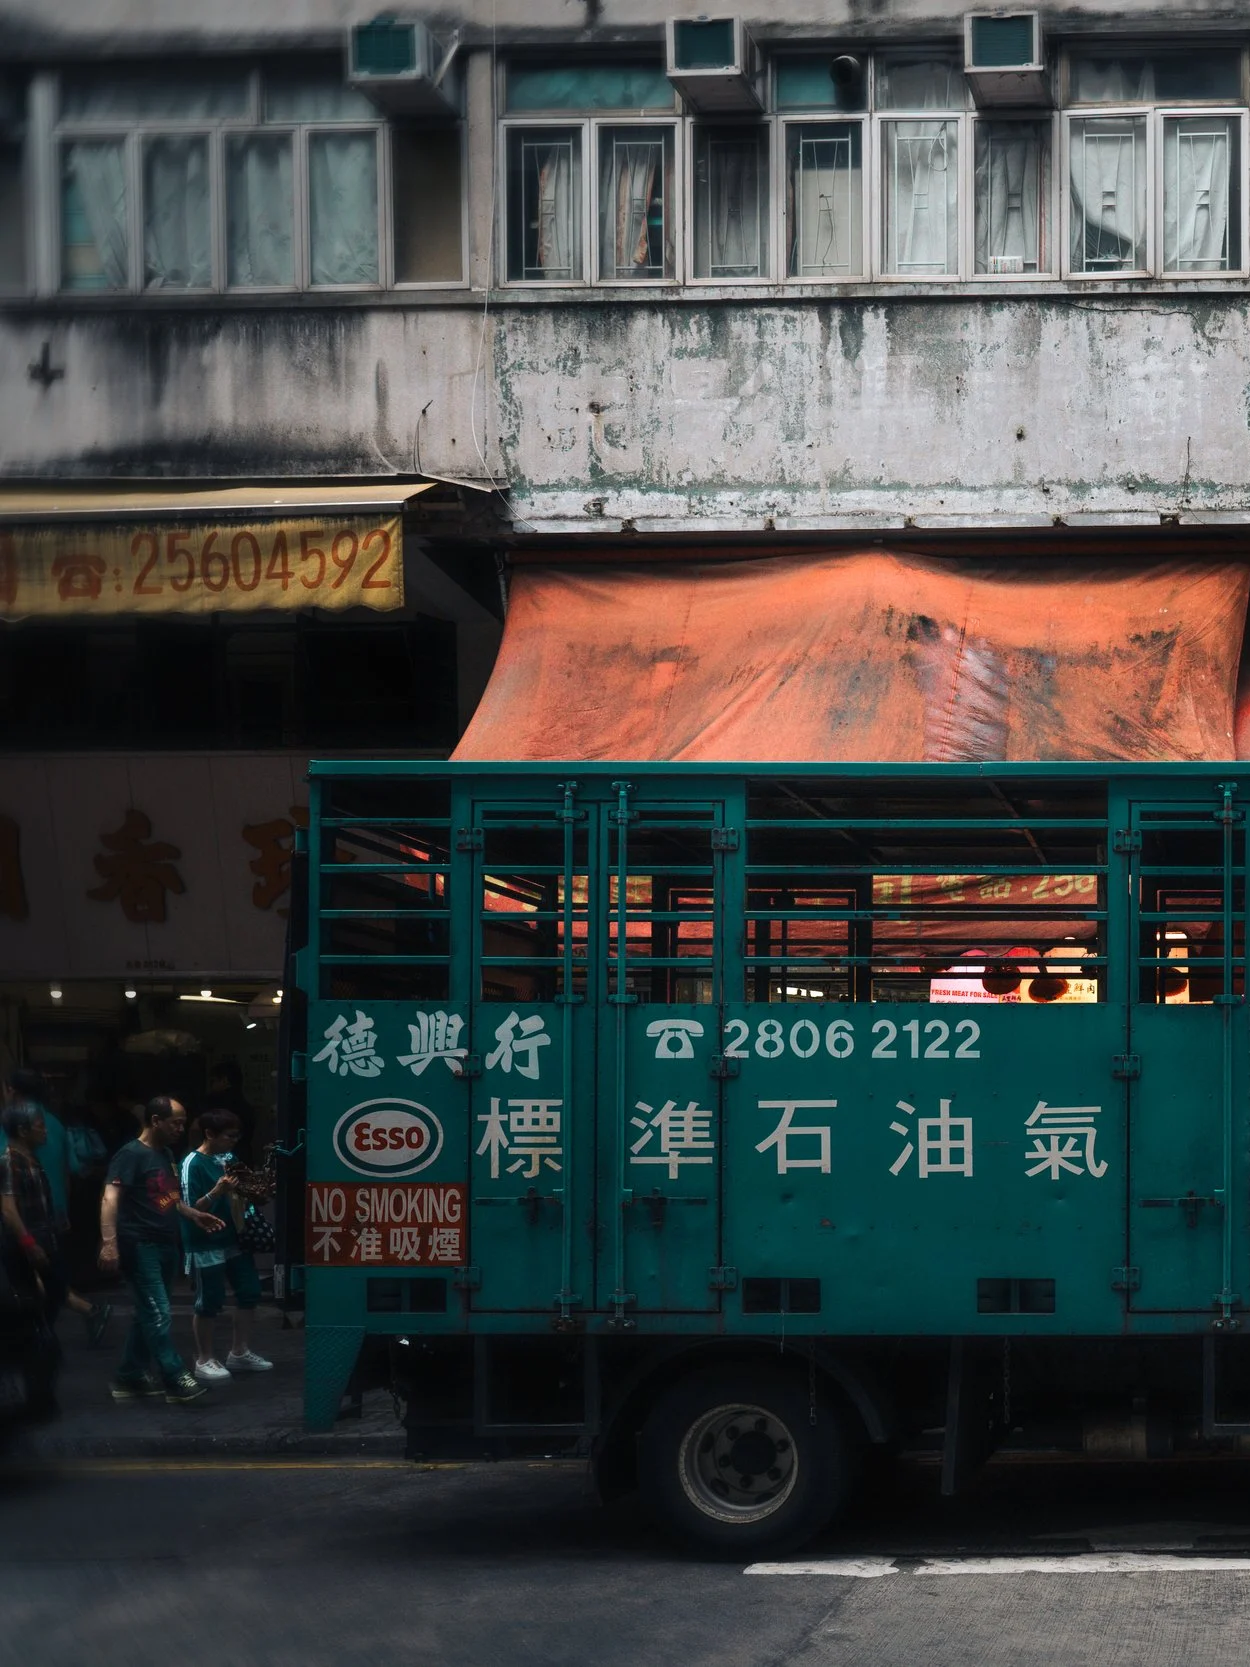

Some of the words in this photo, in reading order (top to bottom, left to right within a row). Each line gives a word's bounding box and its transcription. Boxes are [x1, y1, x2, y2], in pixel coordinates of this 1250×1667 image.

[312, 1010, 551, 1080] 德興行
[724, 1019, 855, 1059] 2806
[871, 1019, 981, 1059] 2122
[354, 1122, 424, 1152] Esso
[476, 1097, 1108, 1180] 標準石油氣
[311, 1188, 347, 1223] NO
[355, 1188, 462, 1223] SMOKING
[311, 1226, 462, 1262] 不准吸煙
